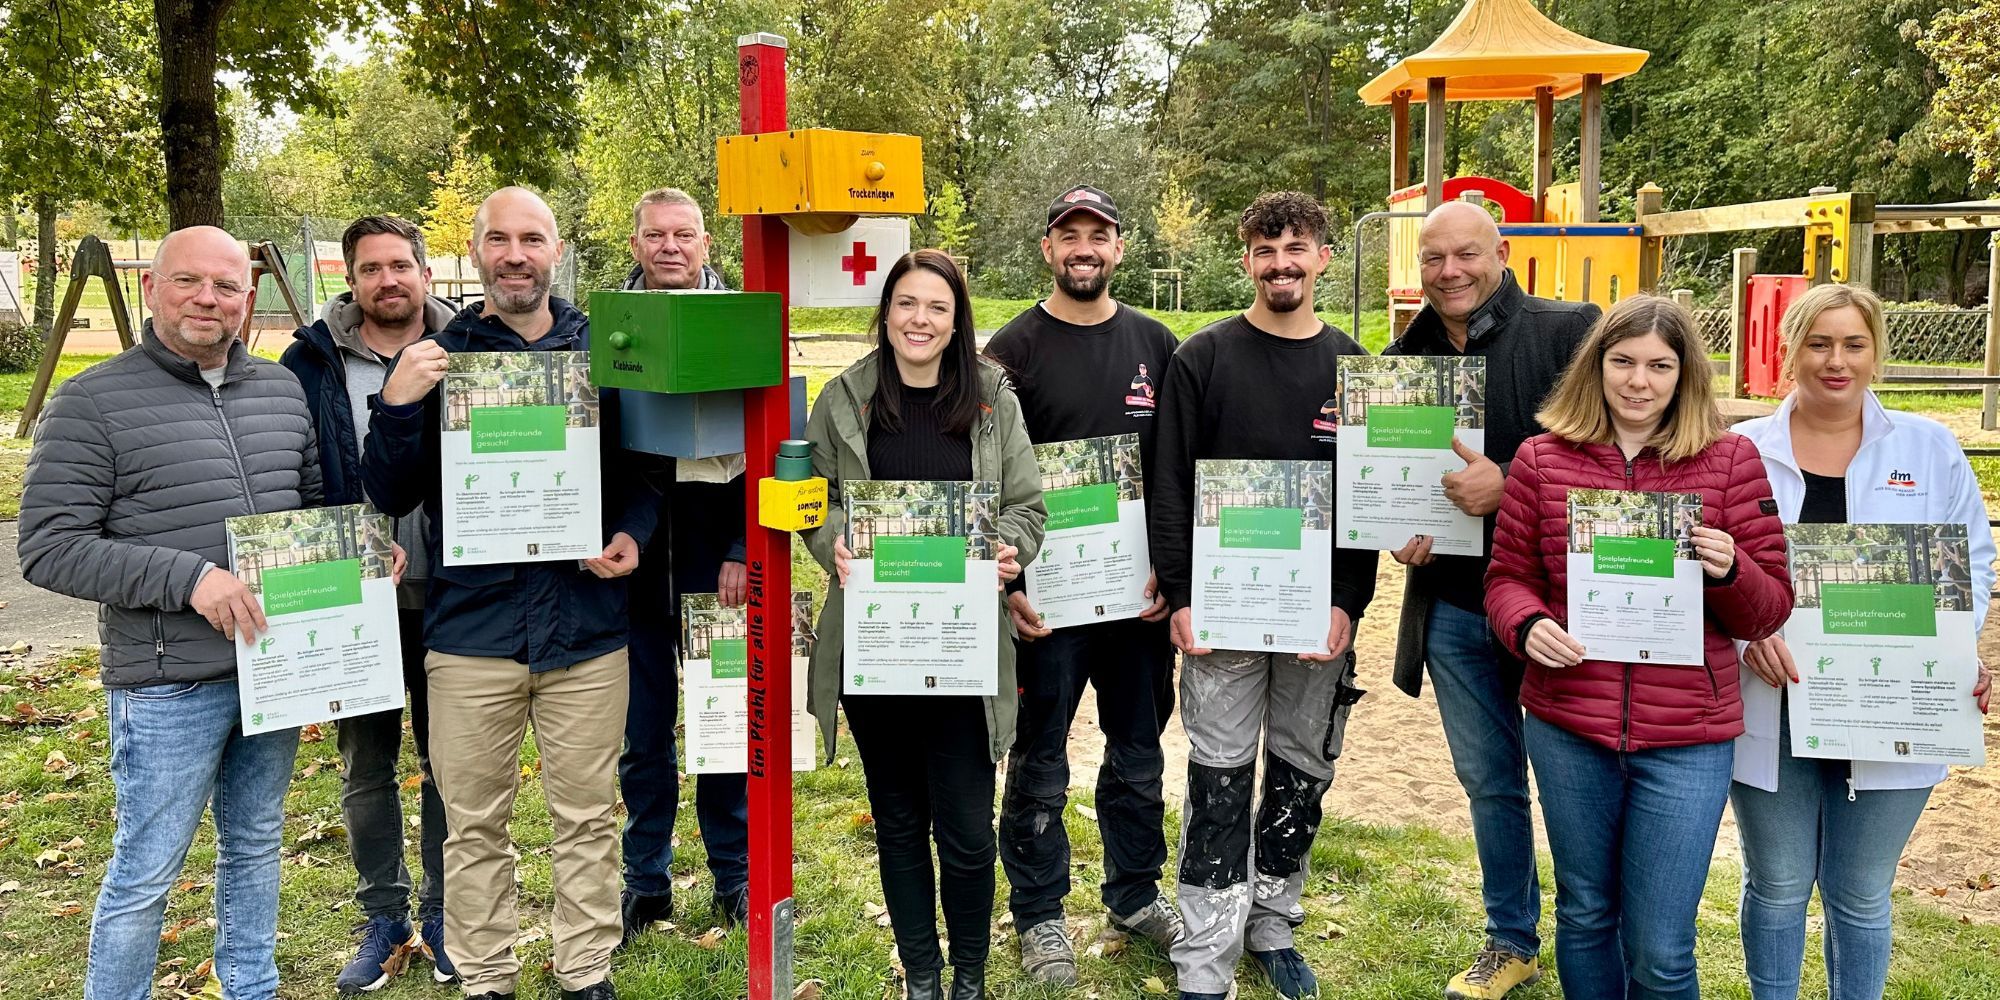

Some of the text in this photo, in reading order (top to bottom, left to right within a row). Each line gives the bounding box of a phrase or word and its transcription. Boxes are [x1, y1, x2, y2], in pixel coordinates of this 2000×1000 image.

[848, 187, 895, 202] Trockenlegen
[613, 359, 644, 373] Klebhände
[476, 429, 543, 439] Spielplatzfreunde
[1372, 426, 1432, 435] Spielplatzfreunde
[476, 439, 509, 448] gesucht!
[1371, 435, 1401, 443] gesucht!
[1890, 469, 1911, 481] dm
[797, 499, 823, 511] sonnige
[804, 514, 819, 525] Tage
[1224, 528, 1281, 537] Spielplatzfreunde
[879, 559, 943, 568] Spielplatzfreunde
[1598, 555, 1654, 564] Spielplatzfreunde
[879, 569, 910, 578] gesucht!
[269, 585, 338, 601] Spielplatzfreunde
[270, 599, 304, 611] gesucht!
[1828, 608, 1906, 619] Spielplatzfreunde
[1829, 620, 1867, 629] gesucht!
[748, 559, 767, 778] Ein Pfahl für alle Fälle
